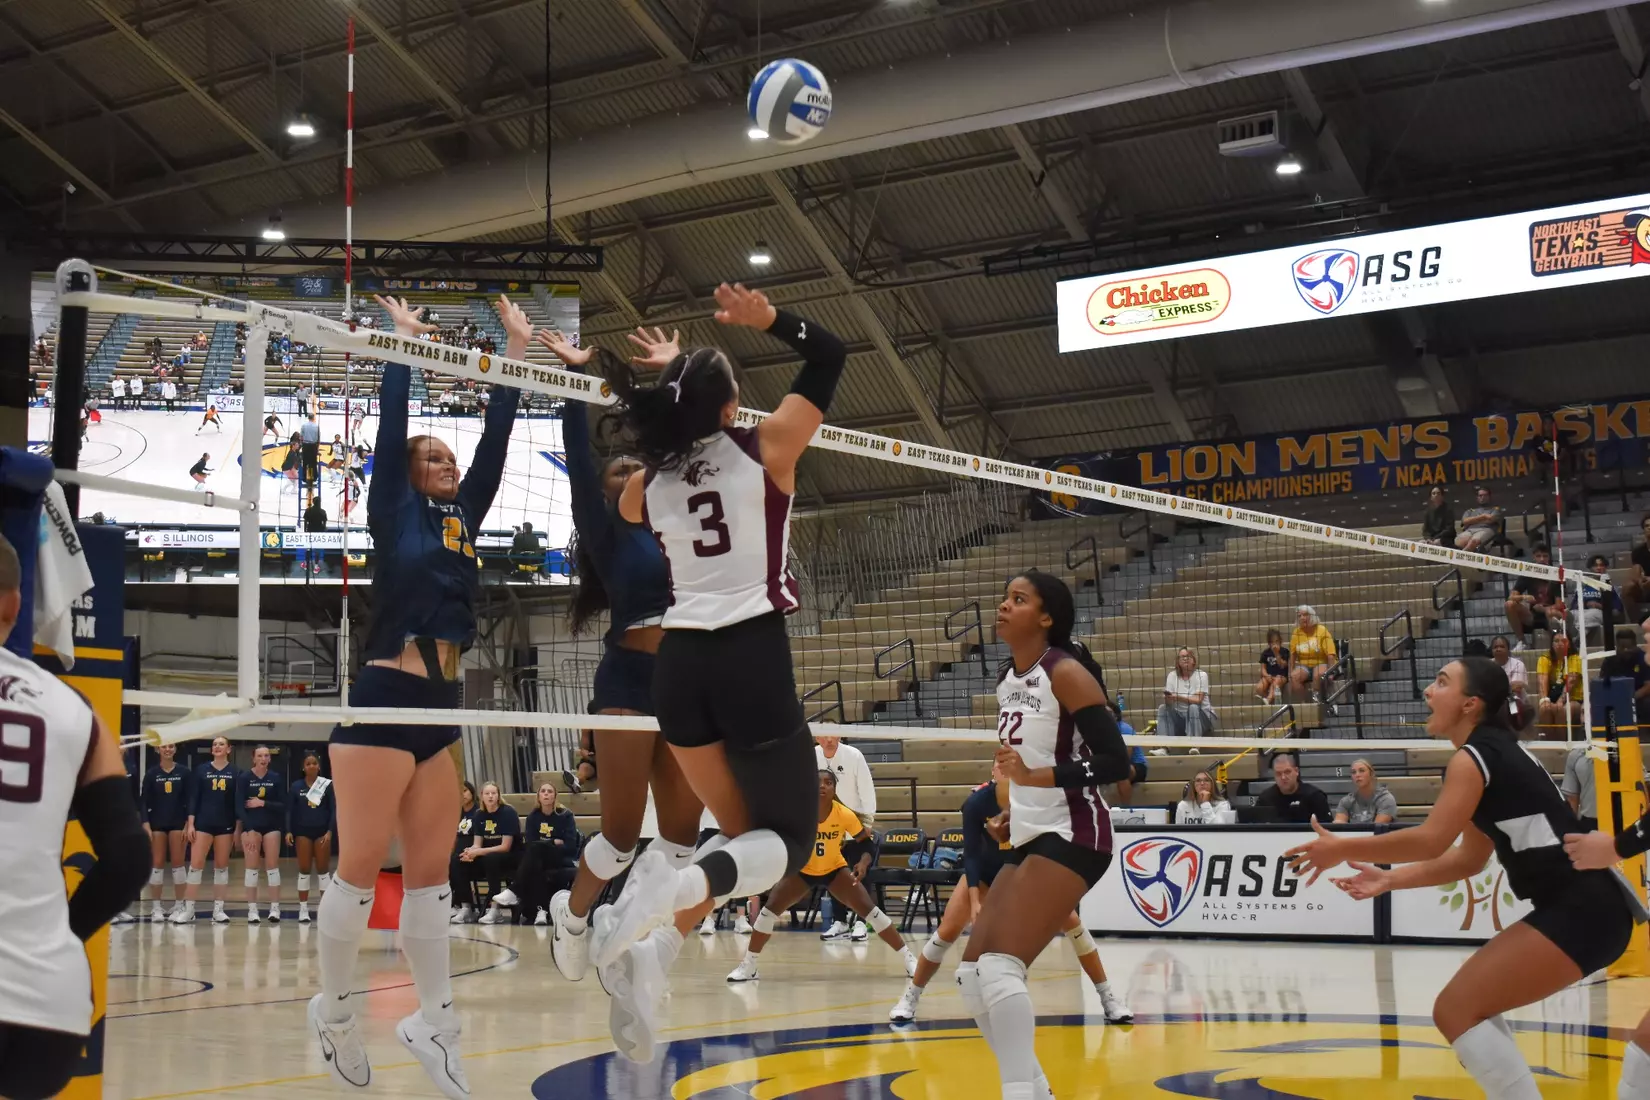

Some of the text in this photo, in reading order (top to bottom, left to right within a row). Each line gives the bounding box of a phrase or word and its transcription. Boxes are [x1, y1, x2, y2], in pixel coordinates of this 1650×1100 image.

[1534, 217, 1600, 239] NORTHEAST
[1534, 230, 1600, 259] TEXAS
[1362, 246, 1442, 287] ASG
[1534, 252, 1603, 273] GELLYBALL
[1106, 281, 1209, 309] Chicken
[1158, 302, 1213, 318] EXPRESS
[368, 334, 468, 366] EAST TEXAS A&M
[501, 363, 591, 392] EAST TEXAS A&M
[229, 398, 244, 407] AS
[737, 411, 749, 422] ST
[821, 428, 886, 451] EAST TEXAS A&M
[907, 446, 967, 467] EAST TEXAS A&M
[1137, 441, 1256, 485] LION
[1276, 421, 1452, 472] MEN'S
[985, 462, 1040, 480] EAST TEXAS A&M
[1379, 448, 1597, 488] 7 NCAA TOURNAS
[1057, 476, 1106, 494] EAST TEXAS A&M
[1212, 471, 1353, 505] CHAMPIONSHIPS
[1121, 490, 1136, 500] EAST
[1137, 493, 1155, 503] TEXAS
[1155, 496, 1167, 506] A&M
[1181, 501, 1194, 511] EAST
[1195, 503, 1211, 513] TEXAS
[687, 491, 731, 557] 3
[163, 534, 214, 542] S ILLINOIS
[285, 534, 343, 543] EAST TEXAS A&M
[998, 711, 1024, 745] 22
[164, 781, 172, 794] 0
[211, 778, 226, 791] 14
[816, 830, 840, 840] ONS
[886, 833, 919, 843] LIONS
[815, 842, 825, 857] 6
[1203, 854, 1301, 898] ASG
[1236, 902, 1297, 910] SYSTEMS
[1306, 902, 1324, 911] GO
[1202, 913, 1257, 921] HVAC-R
